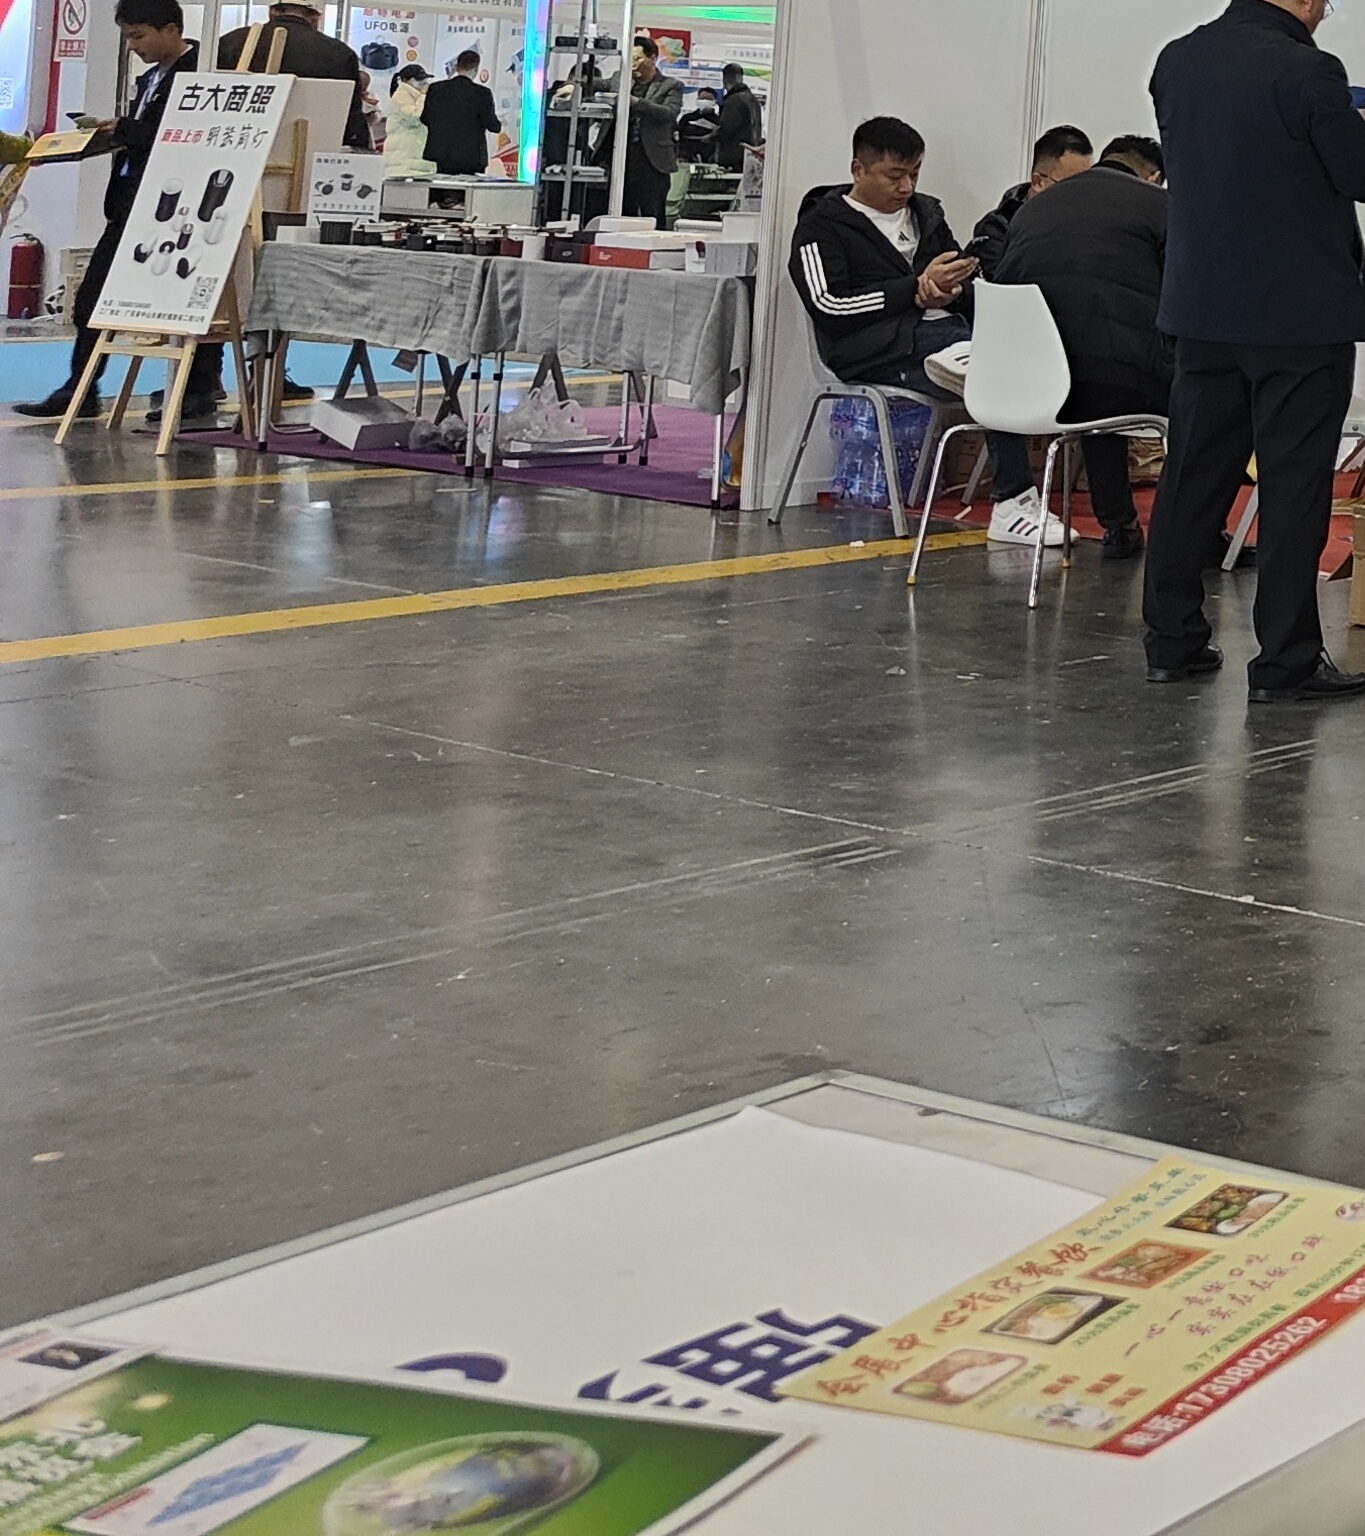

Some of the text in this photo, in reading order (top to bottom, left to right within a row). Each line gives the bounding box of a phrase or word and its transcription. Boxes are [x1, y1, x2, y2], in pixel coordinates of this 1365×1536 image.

[178, 83, 276, 114] 古大商照
[803, 1240, 1107, 1399] 会展中心指定餐饮
[1114, 1315, 1328, 1449] 电话:17308025262
